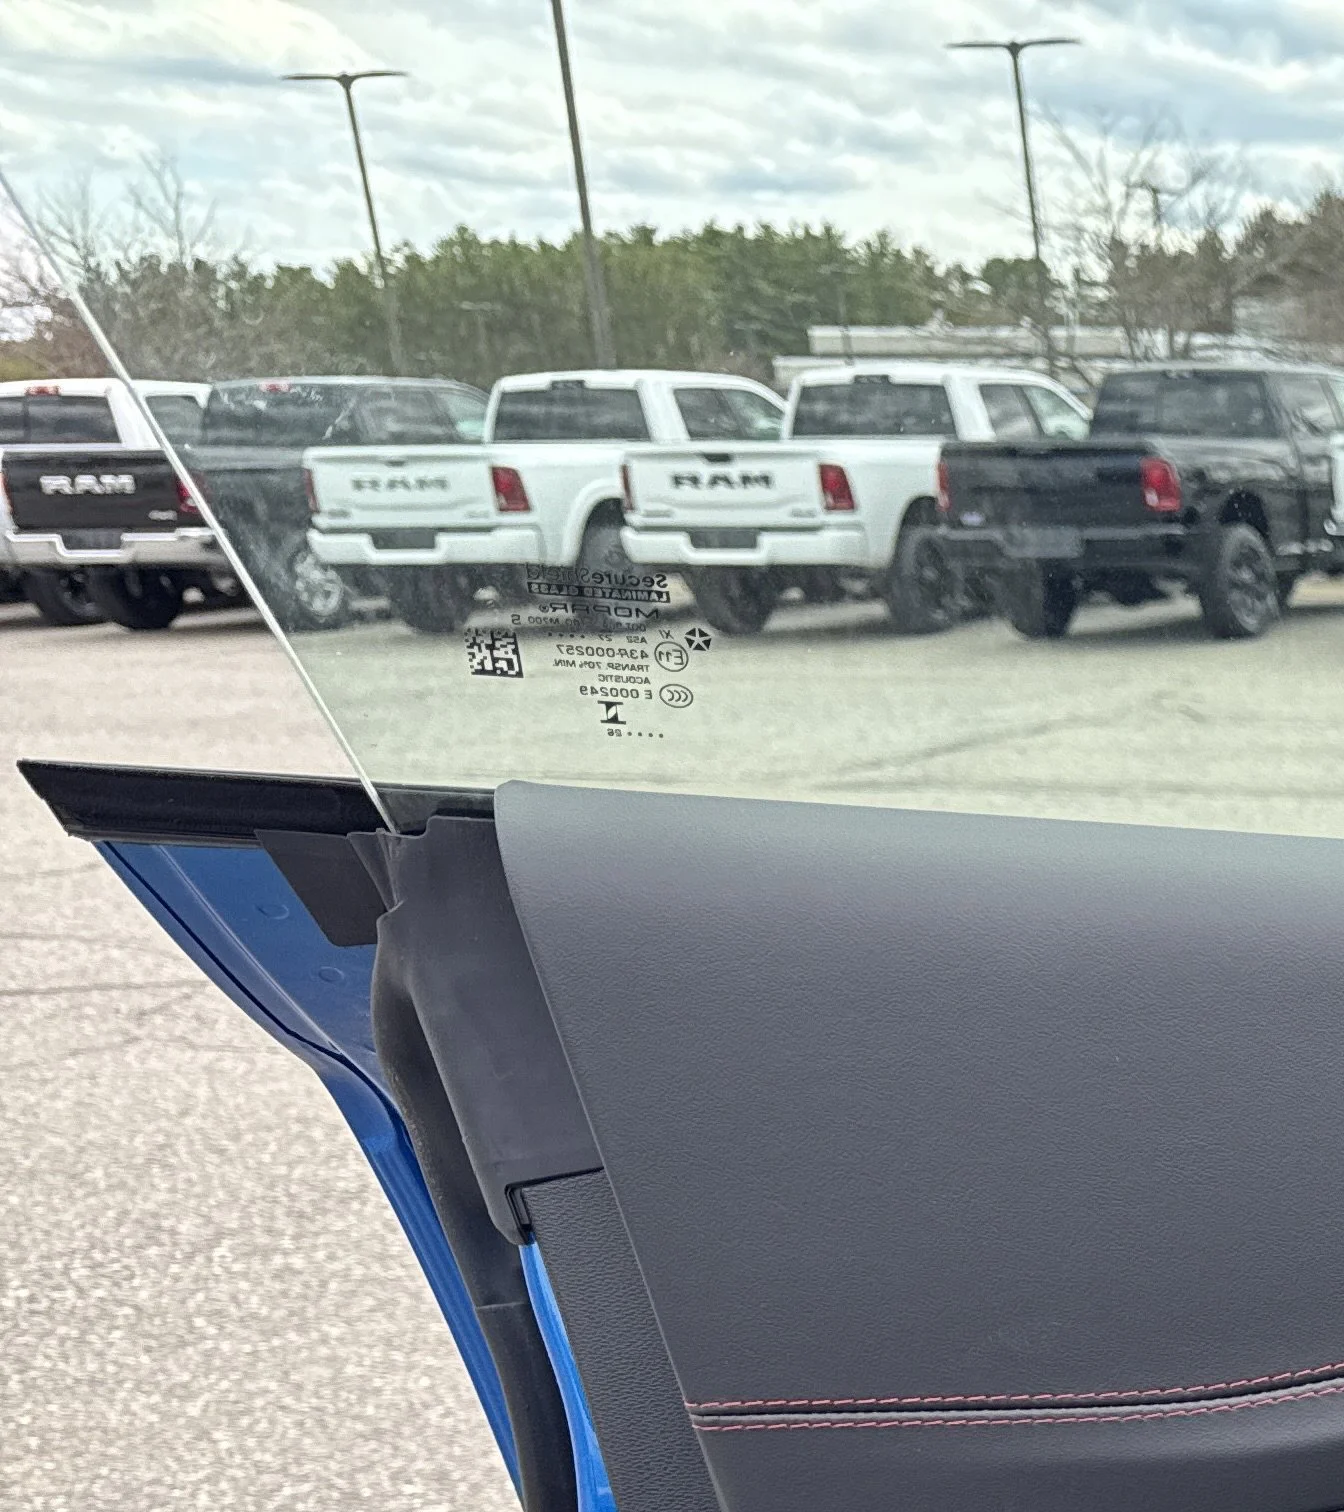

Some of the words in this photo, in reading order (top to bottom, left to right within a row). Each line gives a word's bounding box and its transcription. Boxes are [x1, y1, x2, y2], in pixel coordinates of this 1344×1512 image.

[39, 474, 137, 495] RAM
[352, 476, 449, 492] RAM
[671, 472, 773, 489] RAM
